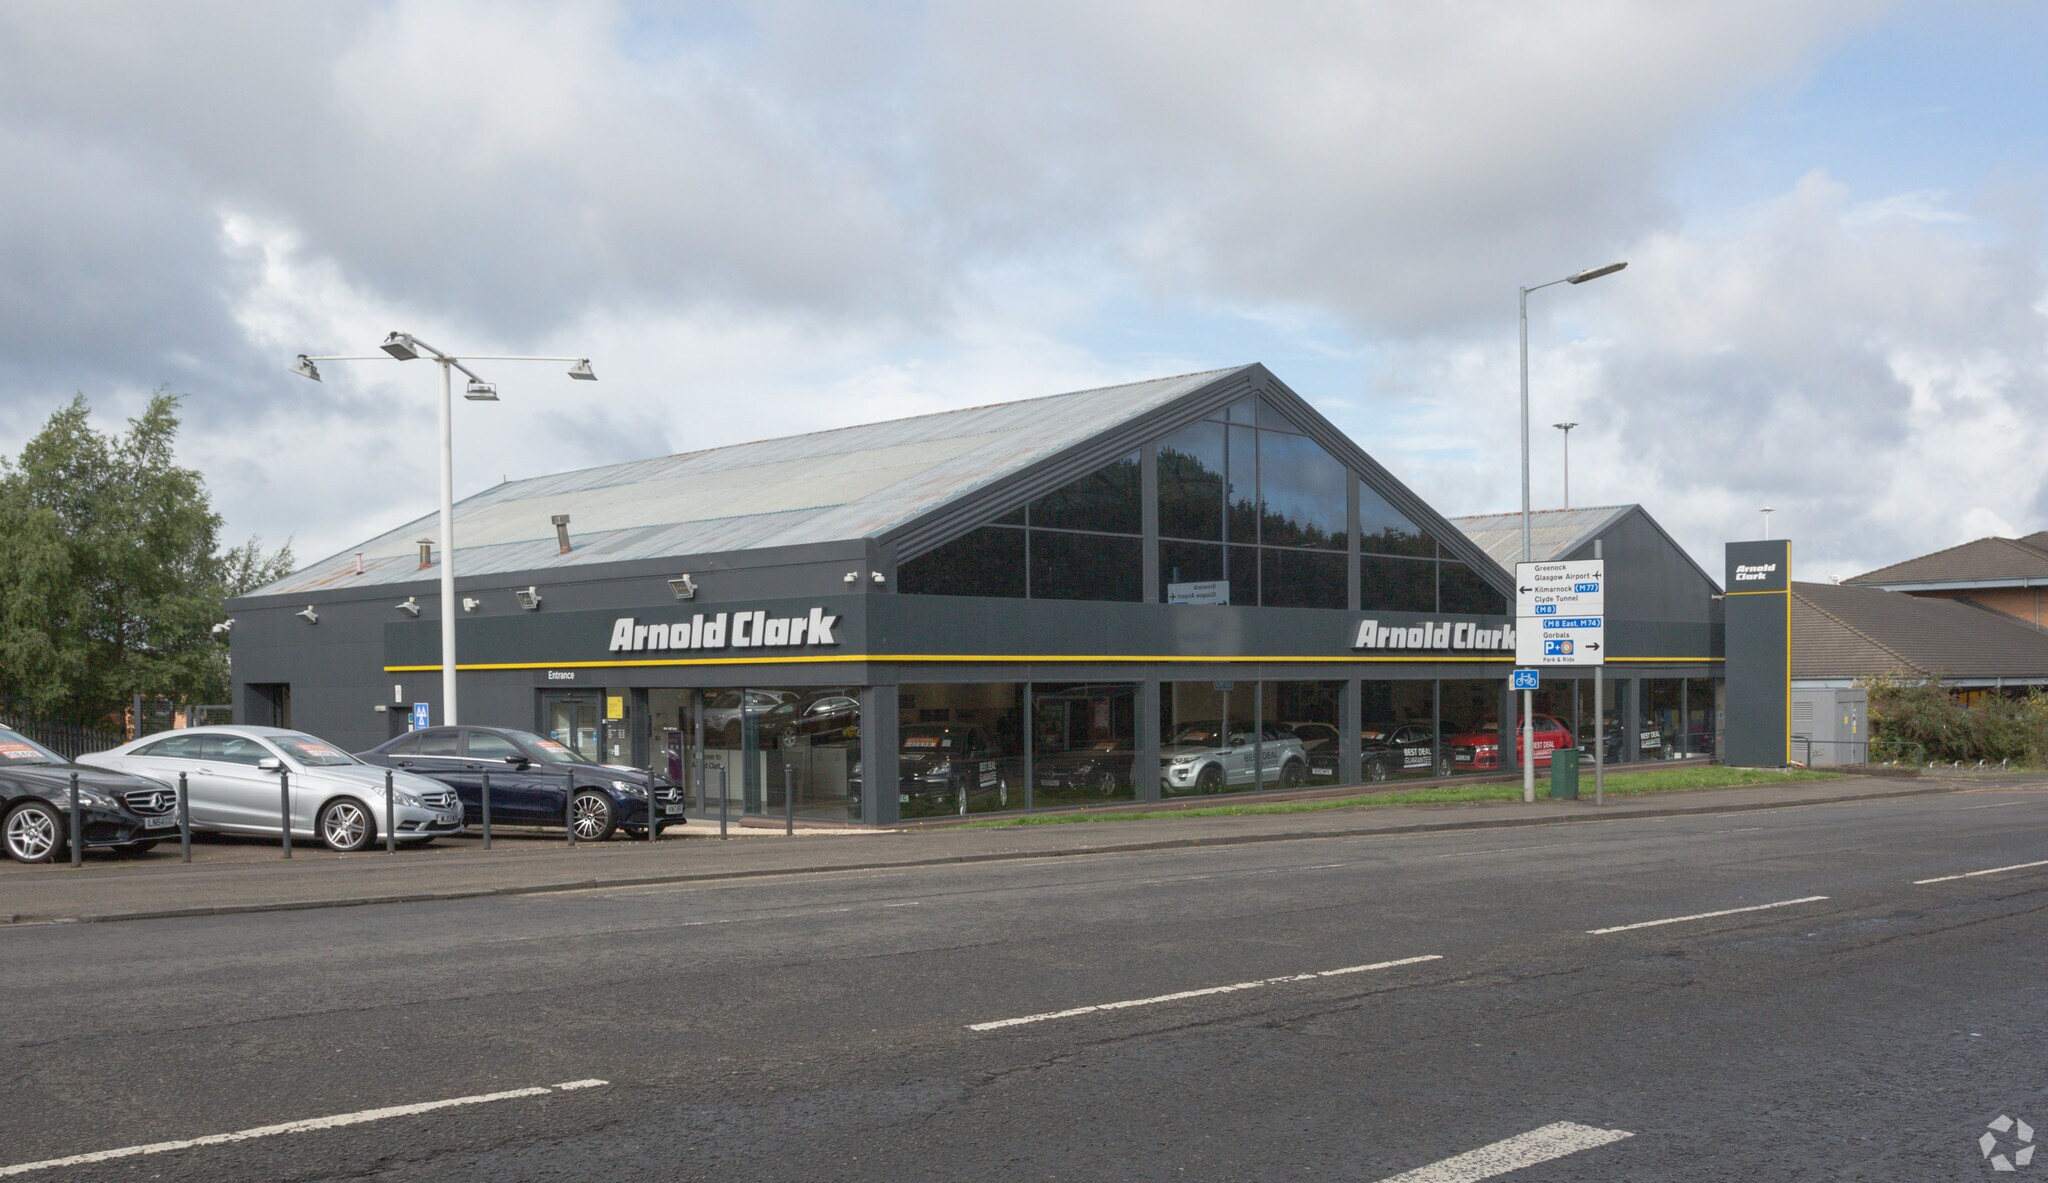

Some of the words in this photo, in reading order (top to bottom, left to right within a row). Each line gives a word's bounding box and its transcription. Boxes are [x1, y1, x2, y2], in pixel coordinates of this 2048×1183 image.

[1736, 564, 1776, 573] Arnold
[1736, 572, 1766, 580] Clark
[1562, 620, 1579, 628] East,
[609, 612, 728, 651] Arnold
[732, 607, 837, 648] Clark
[1354, 619, 1452, 649] Arnold
[1454, 622, 1516, 650] Clark
[548, 670, 575, 680] Entrance
[1244, 753, 1257, 762] BES
[1262, 751, 1278, 760] DEAL
[1404, 748, 1418, 756] BEST
[1418, 748, 1432, 756] DEAL
